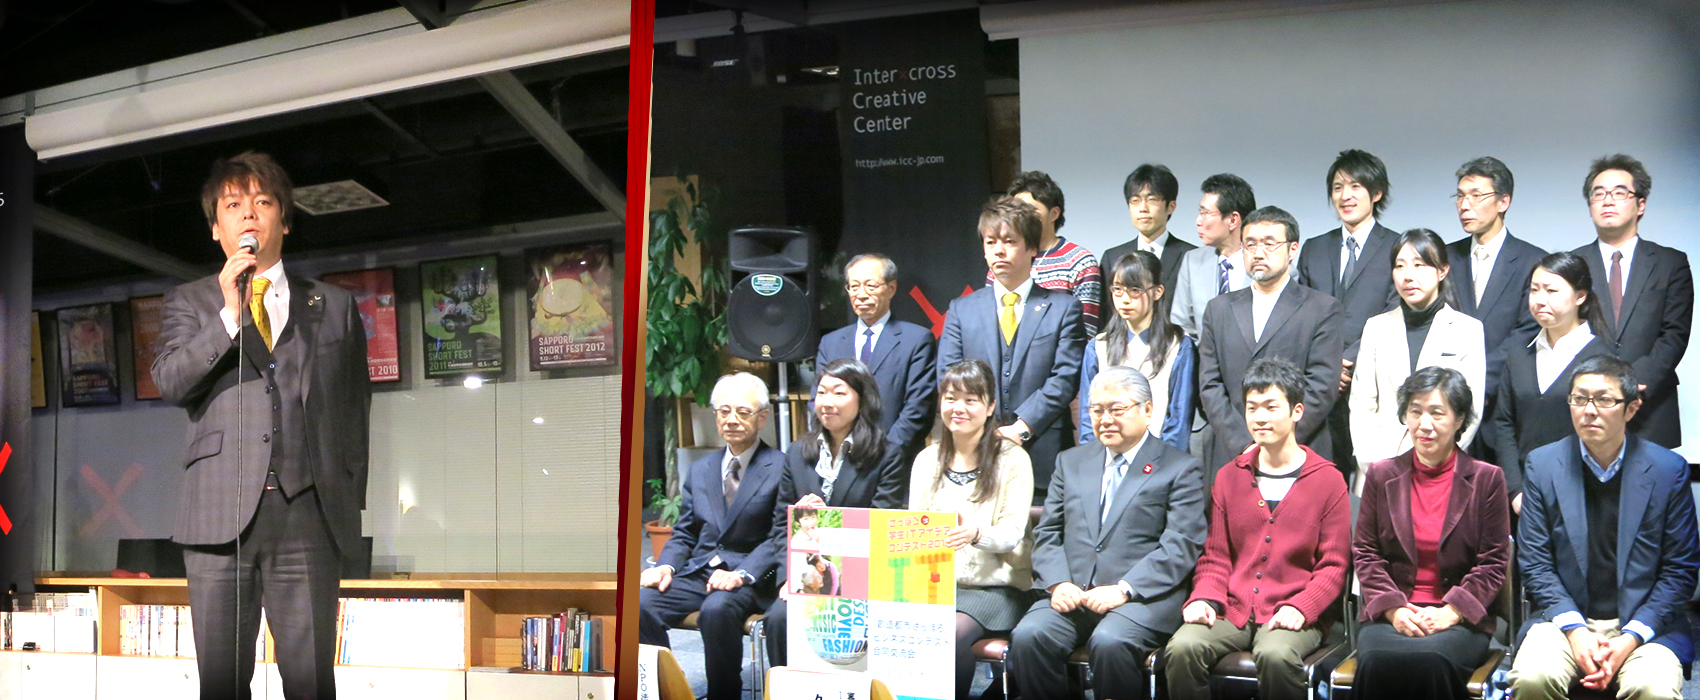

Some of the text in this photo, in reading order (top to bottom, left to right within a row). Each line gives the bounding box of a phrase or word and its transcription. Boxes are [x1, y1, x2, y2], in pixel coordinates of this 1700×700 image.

[854, 64, 957, 85] Inter cross
[852, 89, 927, 109] Creative
[853, 116, 912, 133] Center
[427, 340, 462, 352] SAPPORO
[538, 335, 574, 346] SAPPORO
[539, 342, 606, 355] SHORT FEST 2012
[428, 350, 452, 361] SHORT
[454, 349, 473, 359] FEST
[378, 365, 398, 376] 2010
[429, 361, 447, 371] 2011
